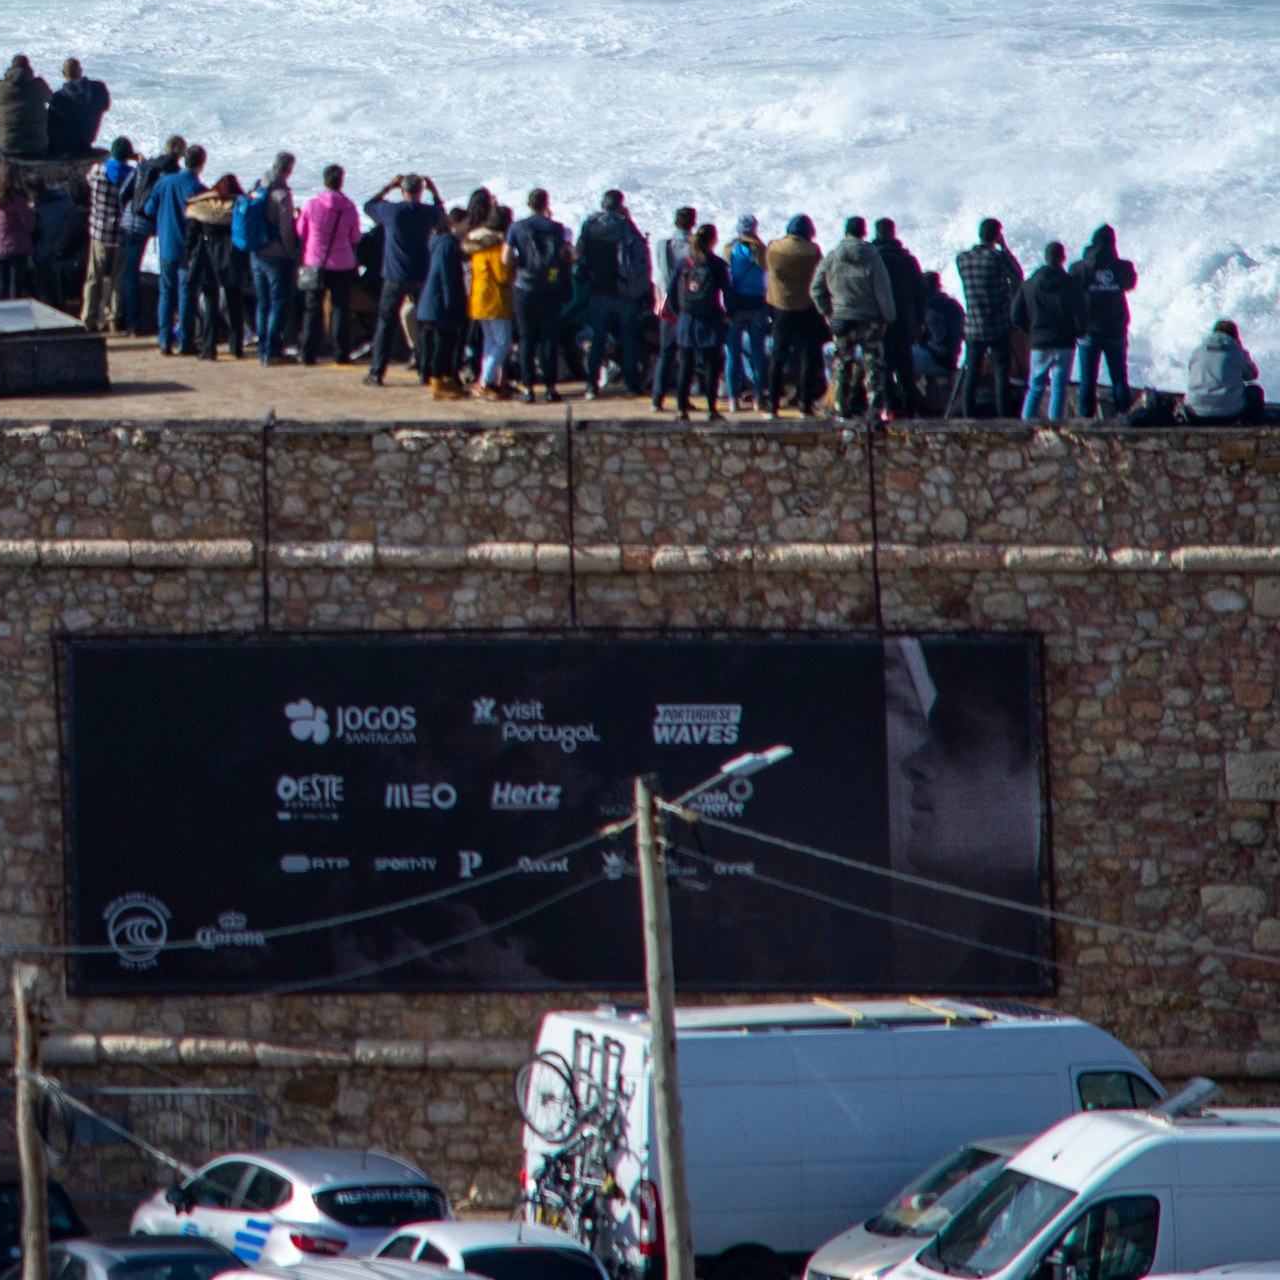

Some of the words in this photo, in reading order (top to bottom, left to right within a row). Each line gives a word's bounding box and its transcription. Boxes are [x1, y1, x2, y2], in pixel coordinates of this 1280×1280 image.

[336, 705, 417, 739] JOGOS
[500, 698, 544, 720] visit
[501, 721, 600, 753] Portugal
[652, 723, 739, 745] WAVES
[277, 773, 344, 801] OESTE
[385, 783, 457, 809] MEO
[492, 782, 561, 806] Hertz
[312, 857, 350, 870] RTP
[458, 850, 482, 878] P
[335, 1189, 431, 1205] REPORTAGEM
